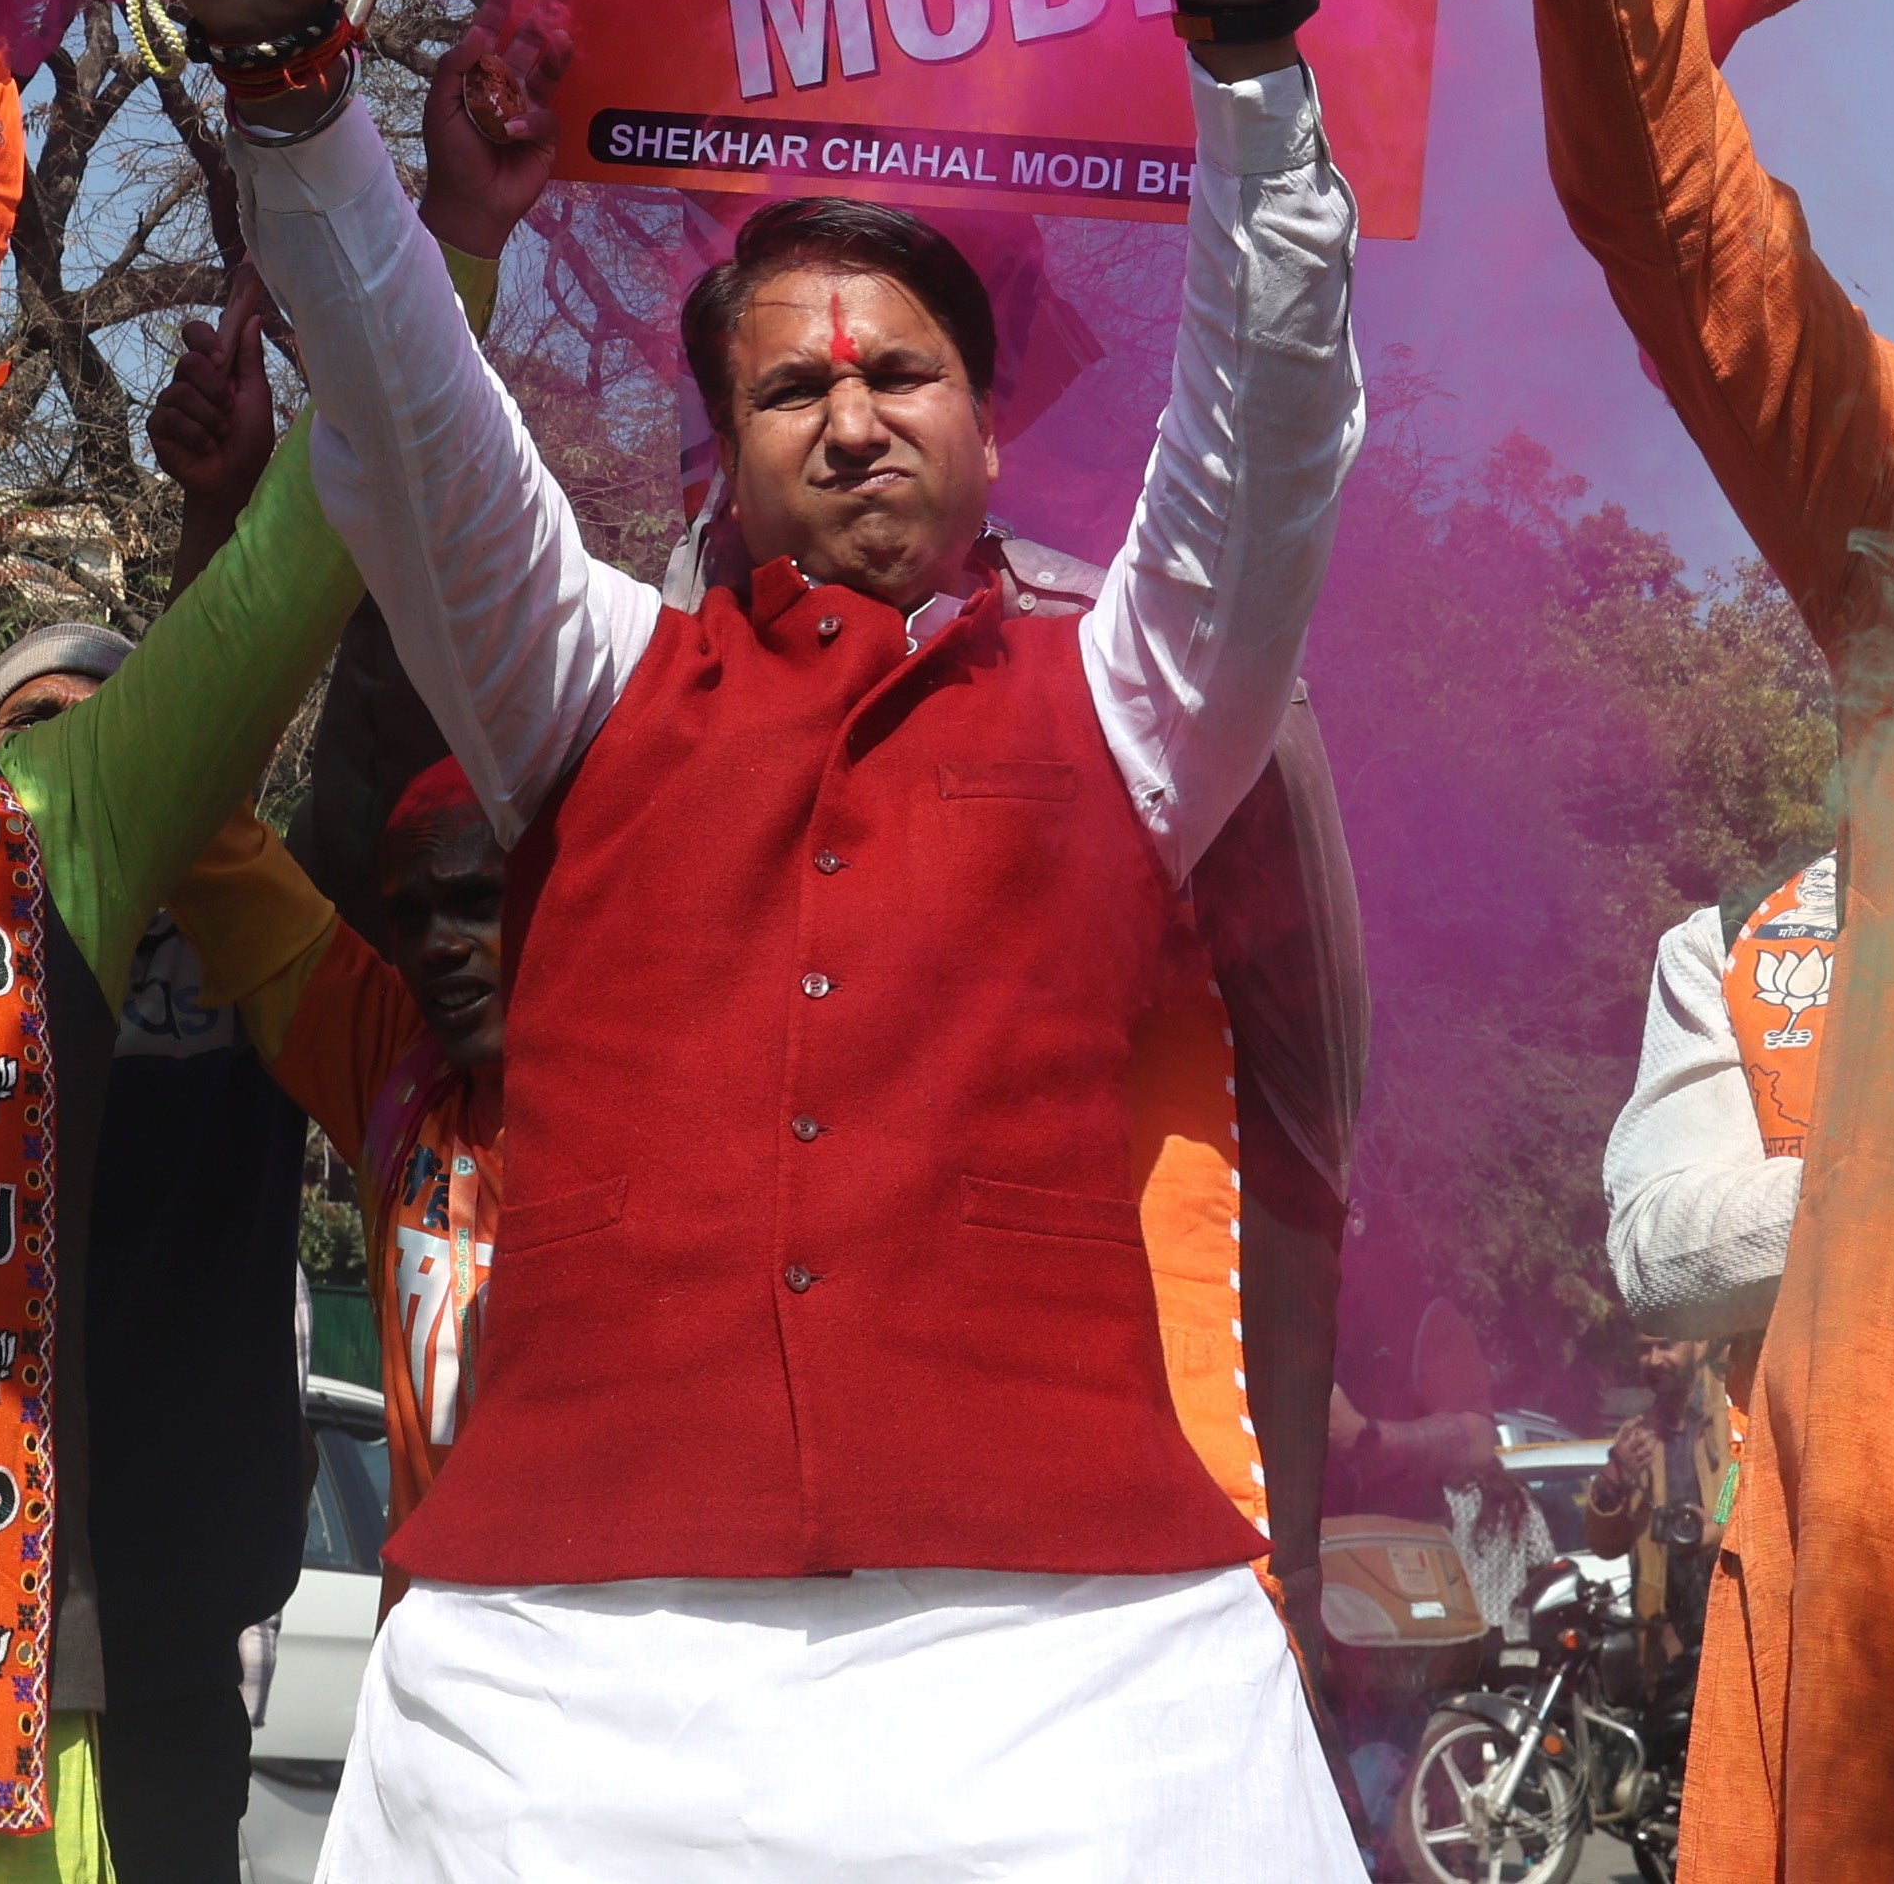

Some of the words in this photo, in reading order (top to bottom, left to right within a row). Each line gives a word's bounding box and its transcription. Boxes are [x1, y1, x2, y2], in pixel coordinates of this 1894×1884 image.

[608, 124, 807, 171] SHEKHAR
[821, 135, 998, 183] CHAHAL
[1011, 150, 1123, 192] MODI
[1137, 160, 1196, 197] BH
[1778, 925, 1808, 938] मोदी
